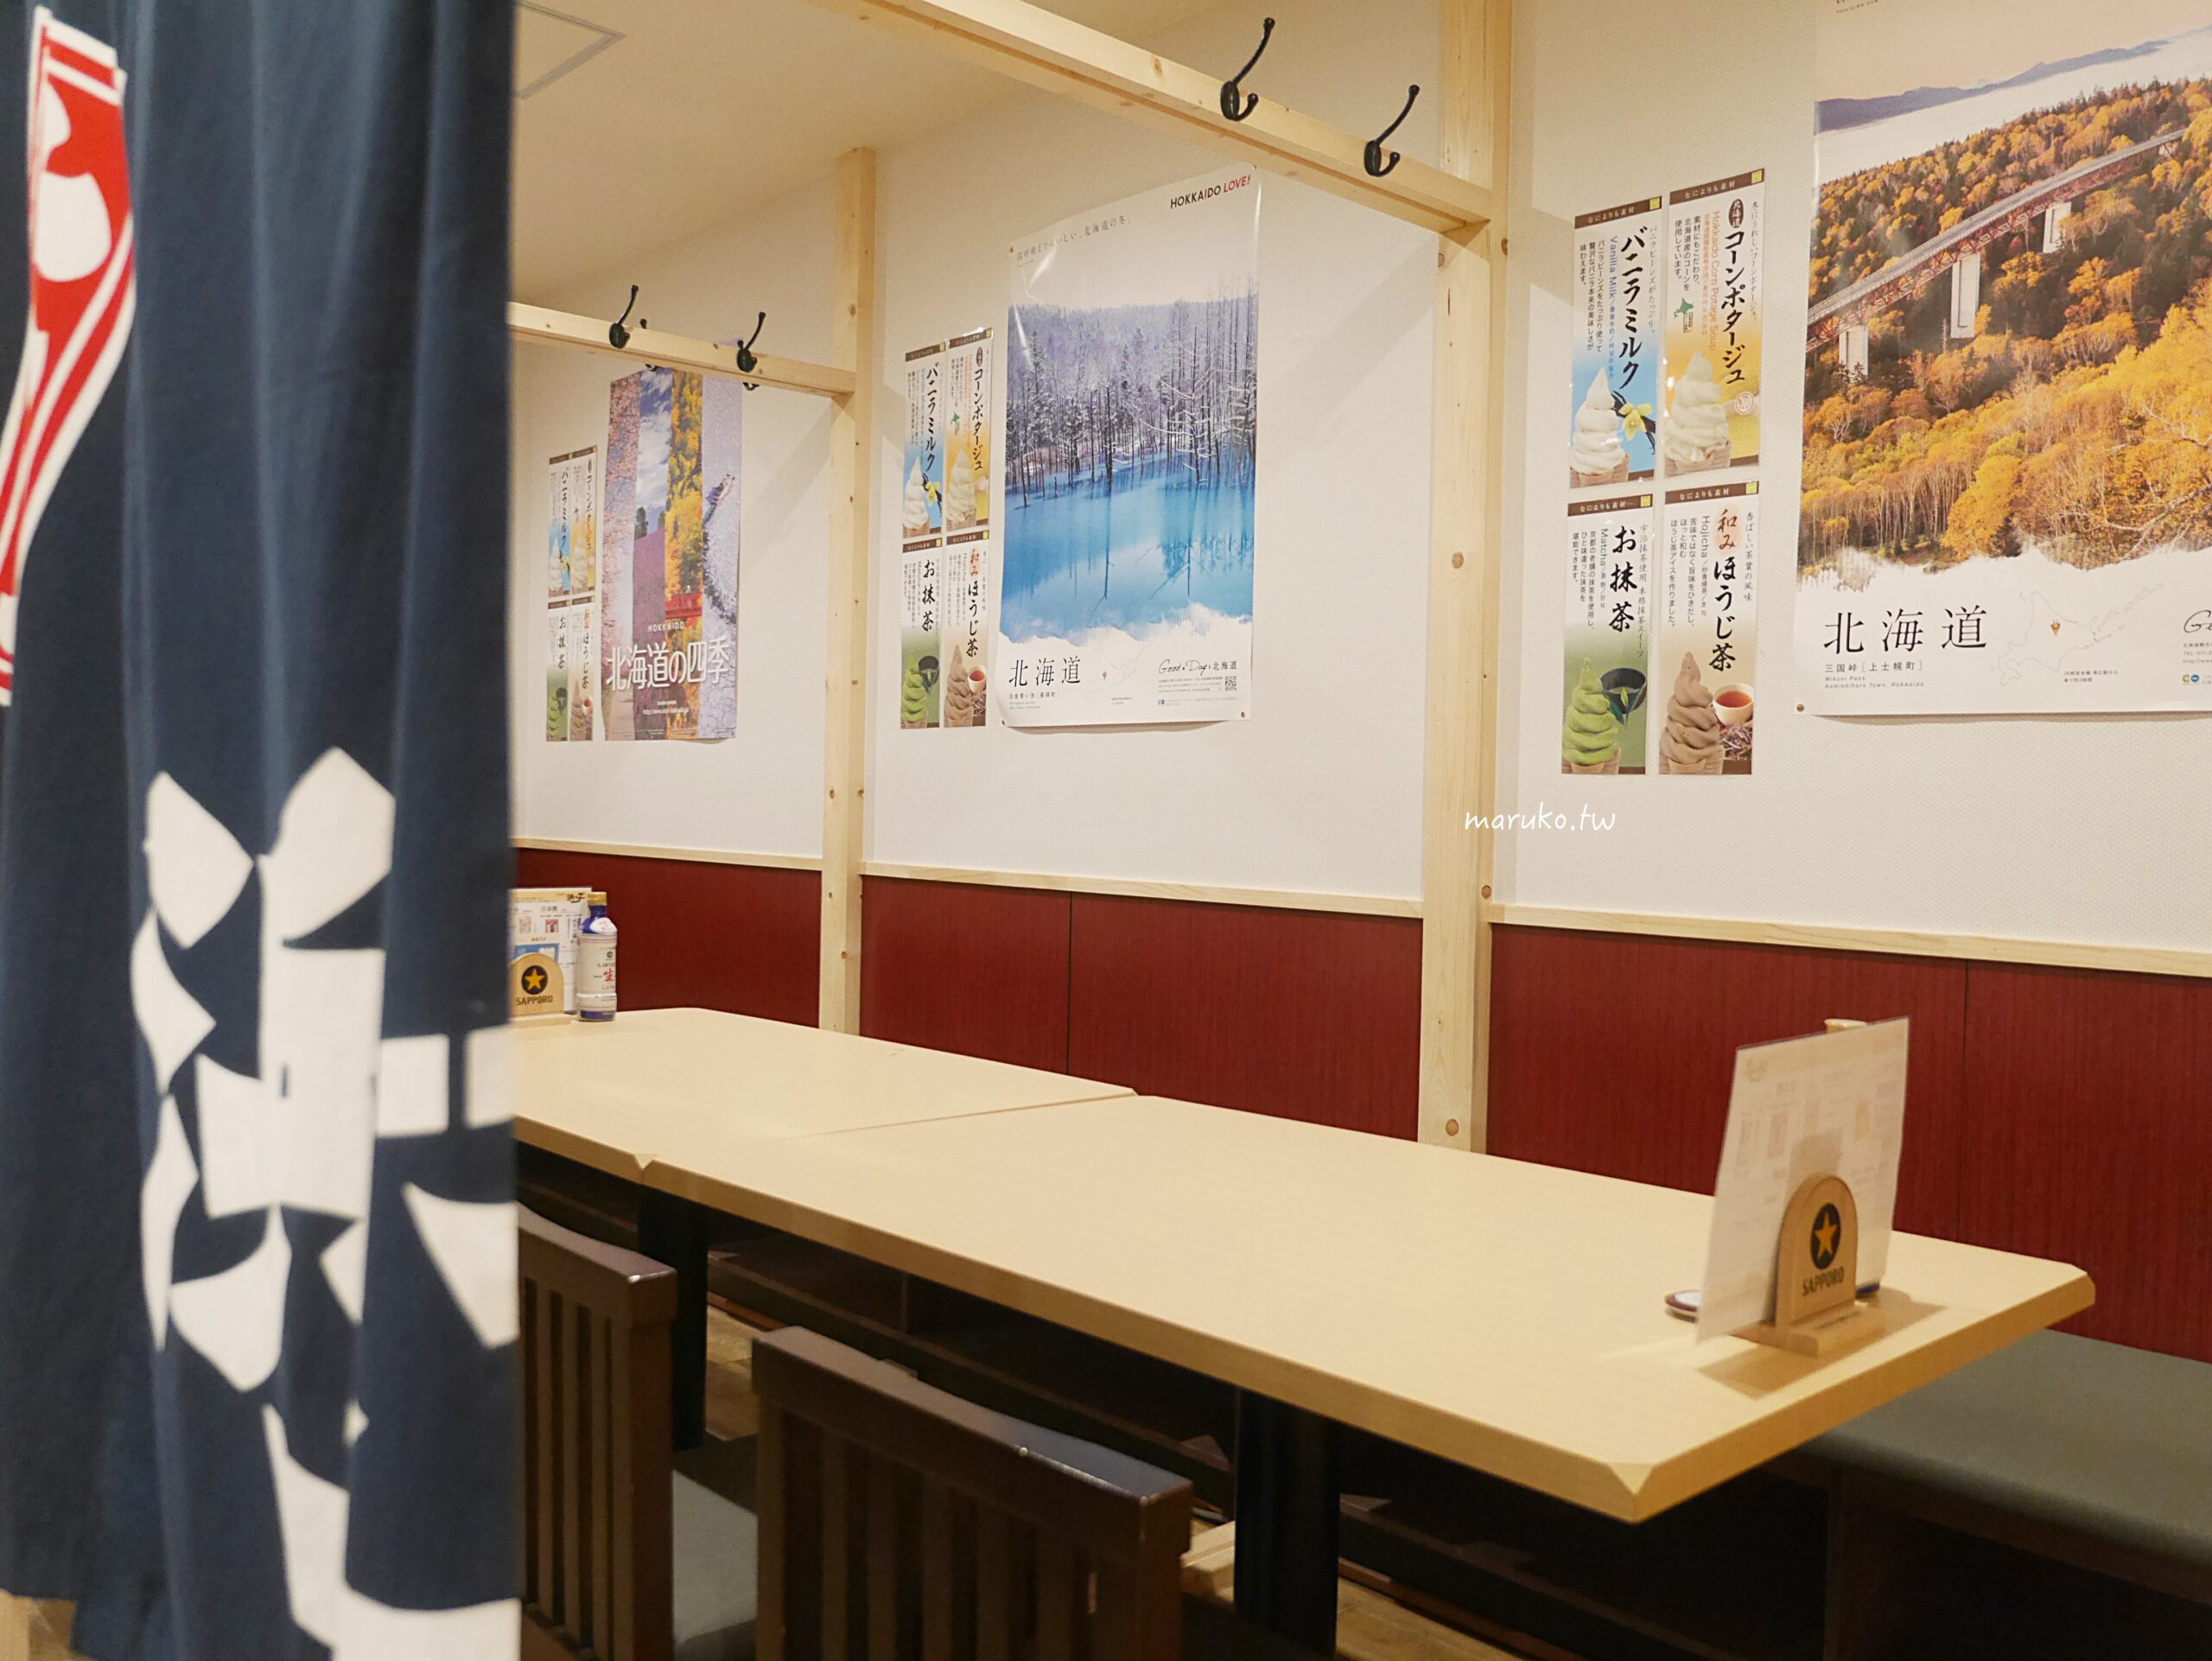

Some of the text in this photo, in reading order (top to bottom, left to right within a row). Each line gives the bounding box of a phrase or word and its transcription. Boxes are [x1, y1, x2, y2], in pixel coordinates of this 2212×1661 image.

[1170, 175, 1251, 209] HOKKAIDO LOVE!
[1685, 181, 1736, 199] なによりも素材
[1588, 207, 1634, 223] なによりも素材
[1731, 200, 1742, 227] 北海道
[1609, 235, 1618, 273] Vanilla
[1709, 211, 1721, 352] Hokkaido Corn Potage Soup
[1620, 226, 1648, 390] バニラミルク
[1721, 231, 1745, 385] コーンポタージュ
[925, 361, 940, 472] バニラミルク
[973, 368, 983, 471] コーンポタージュ
[1580, 501, 1625, 512] なによりも素材
[1680, 488, 1729, 500] なによりも素材
[1700, 516, 1710, 558] Hojicha
[1580, 531, 1588, 601] ひと味違った抹茶を
[1608, 525, 1637, 633] お抹茶
[1669, 519, 1677, 627] ほうじ茶アイスを作りました。
[922, 558, 936, 632] お抹茶
[648, 621, 685, 633] HOKKAIDO
[1823, 604, 1987, 655] 北海道
[606, 635, 731, 690] 北海道の四季
[1009, 655, 1081, 687] 北海道
[516, 995, 554, 1006] SAPPORO
[1802, 1266, 1845, 1296] SAPPORO
